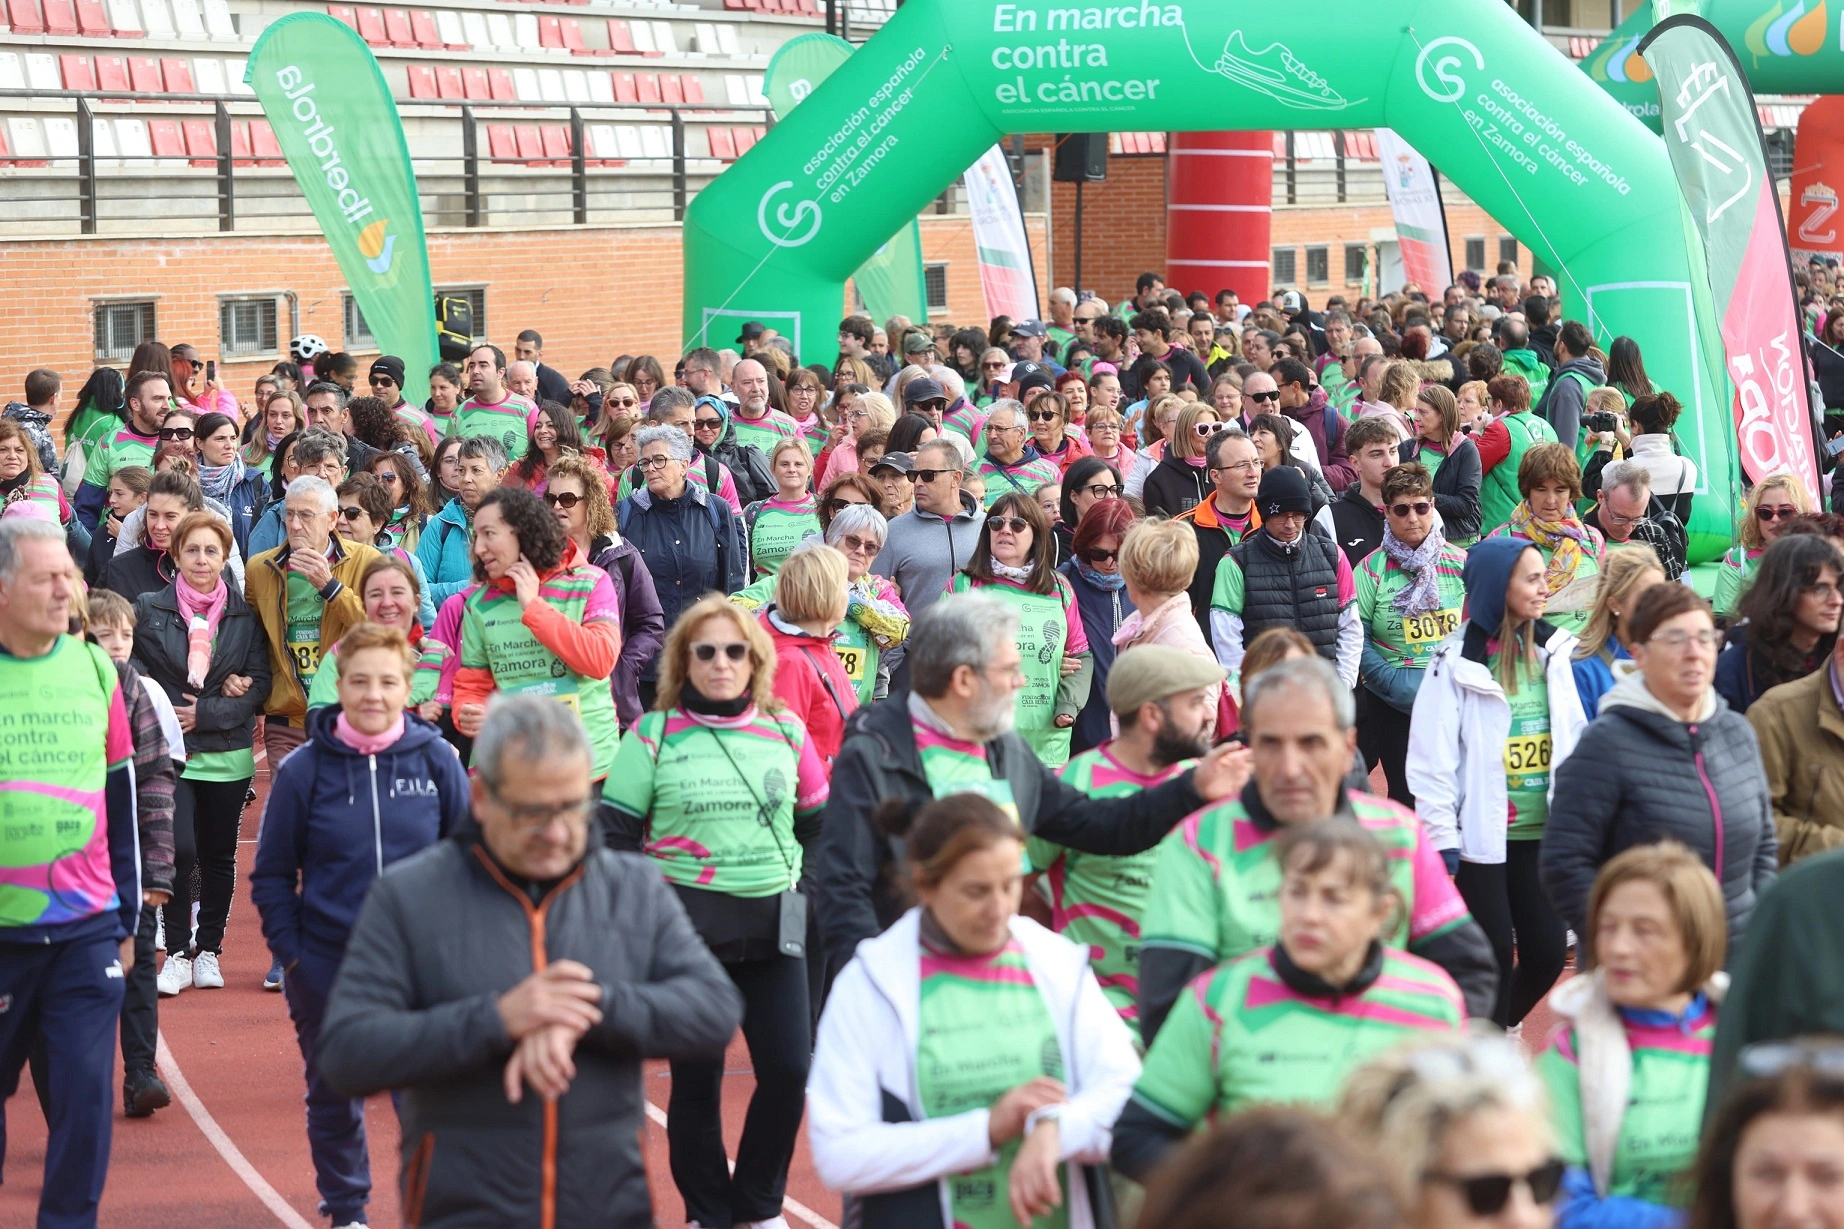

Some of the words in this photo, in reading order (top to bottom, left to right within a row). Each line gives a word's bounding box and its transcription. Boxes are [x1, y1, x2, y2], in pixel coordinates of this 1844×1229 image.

[993, 3, 1037, 33] En
[1046, 1, 1184, 31] marcha
[991, 38, 1109, 70] contra
[995, 76, 1031, 104] el
[1037, 74, 1160, 103] cáncer
[803, 106, 870, 175] asociación
[868, 47, 926, 108] española
[816, 145, 860, 190] contra
[857, 129, 873, 147] el
[871, 87, 914, 135] cáncer
[1464, 108, 1484, 130] en
[1482, 122, 1539, 175] Zamora
[1477, 93, 1524, 135] contra
[1523, 131, 1541, 148] el
[1538, 142, 1589, 187] cáncer
[1491, 78, 1567, 143] asociación
[1565, 139, 1632, 196] española
[830, 183, 850, 203] en
[845, 134, 899, 187] Zamora
[756, 546, 795, 556] Zamora
[1409, 612, 1458, 639] 3078
[489, 644, 501, 652] En
[503, 639, 543, 650] Marcha
[493, 658, 547, 674] Zamora
[21, 709, 93, 726] marcha
[18, 747, 88, 766] cáncer
[395, 778, 439, 796] FILA
[680, 780, 697, 790] En
[682, 800, 753, 816] Zamora
